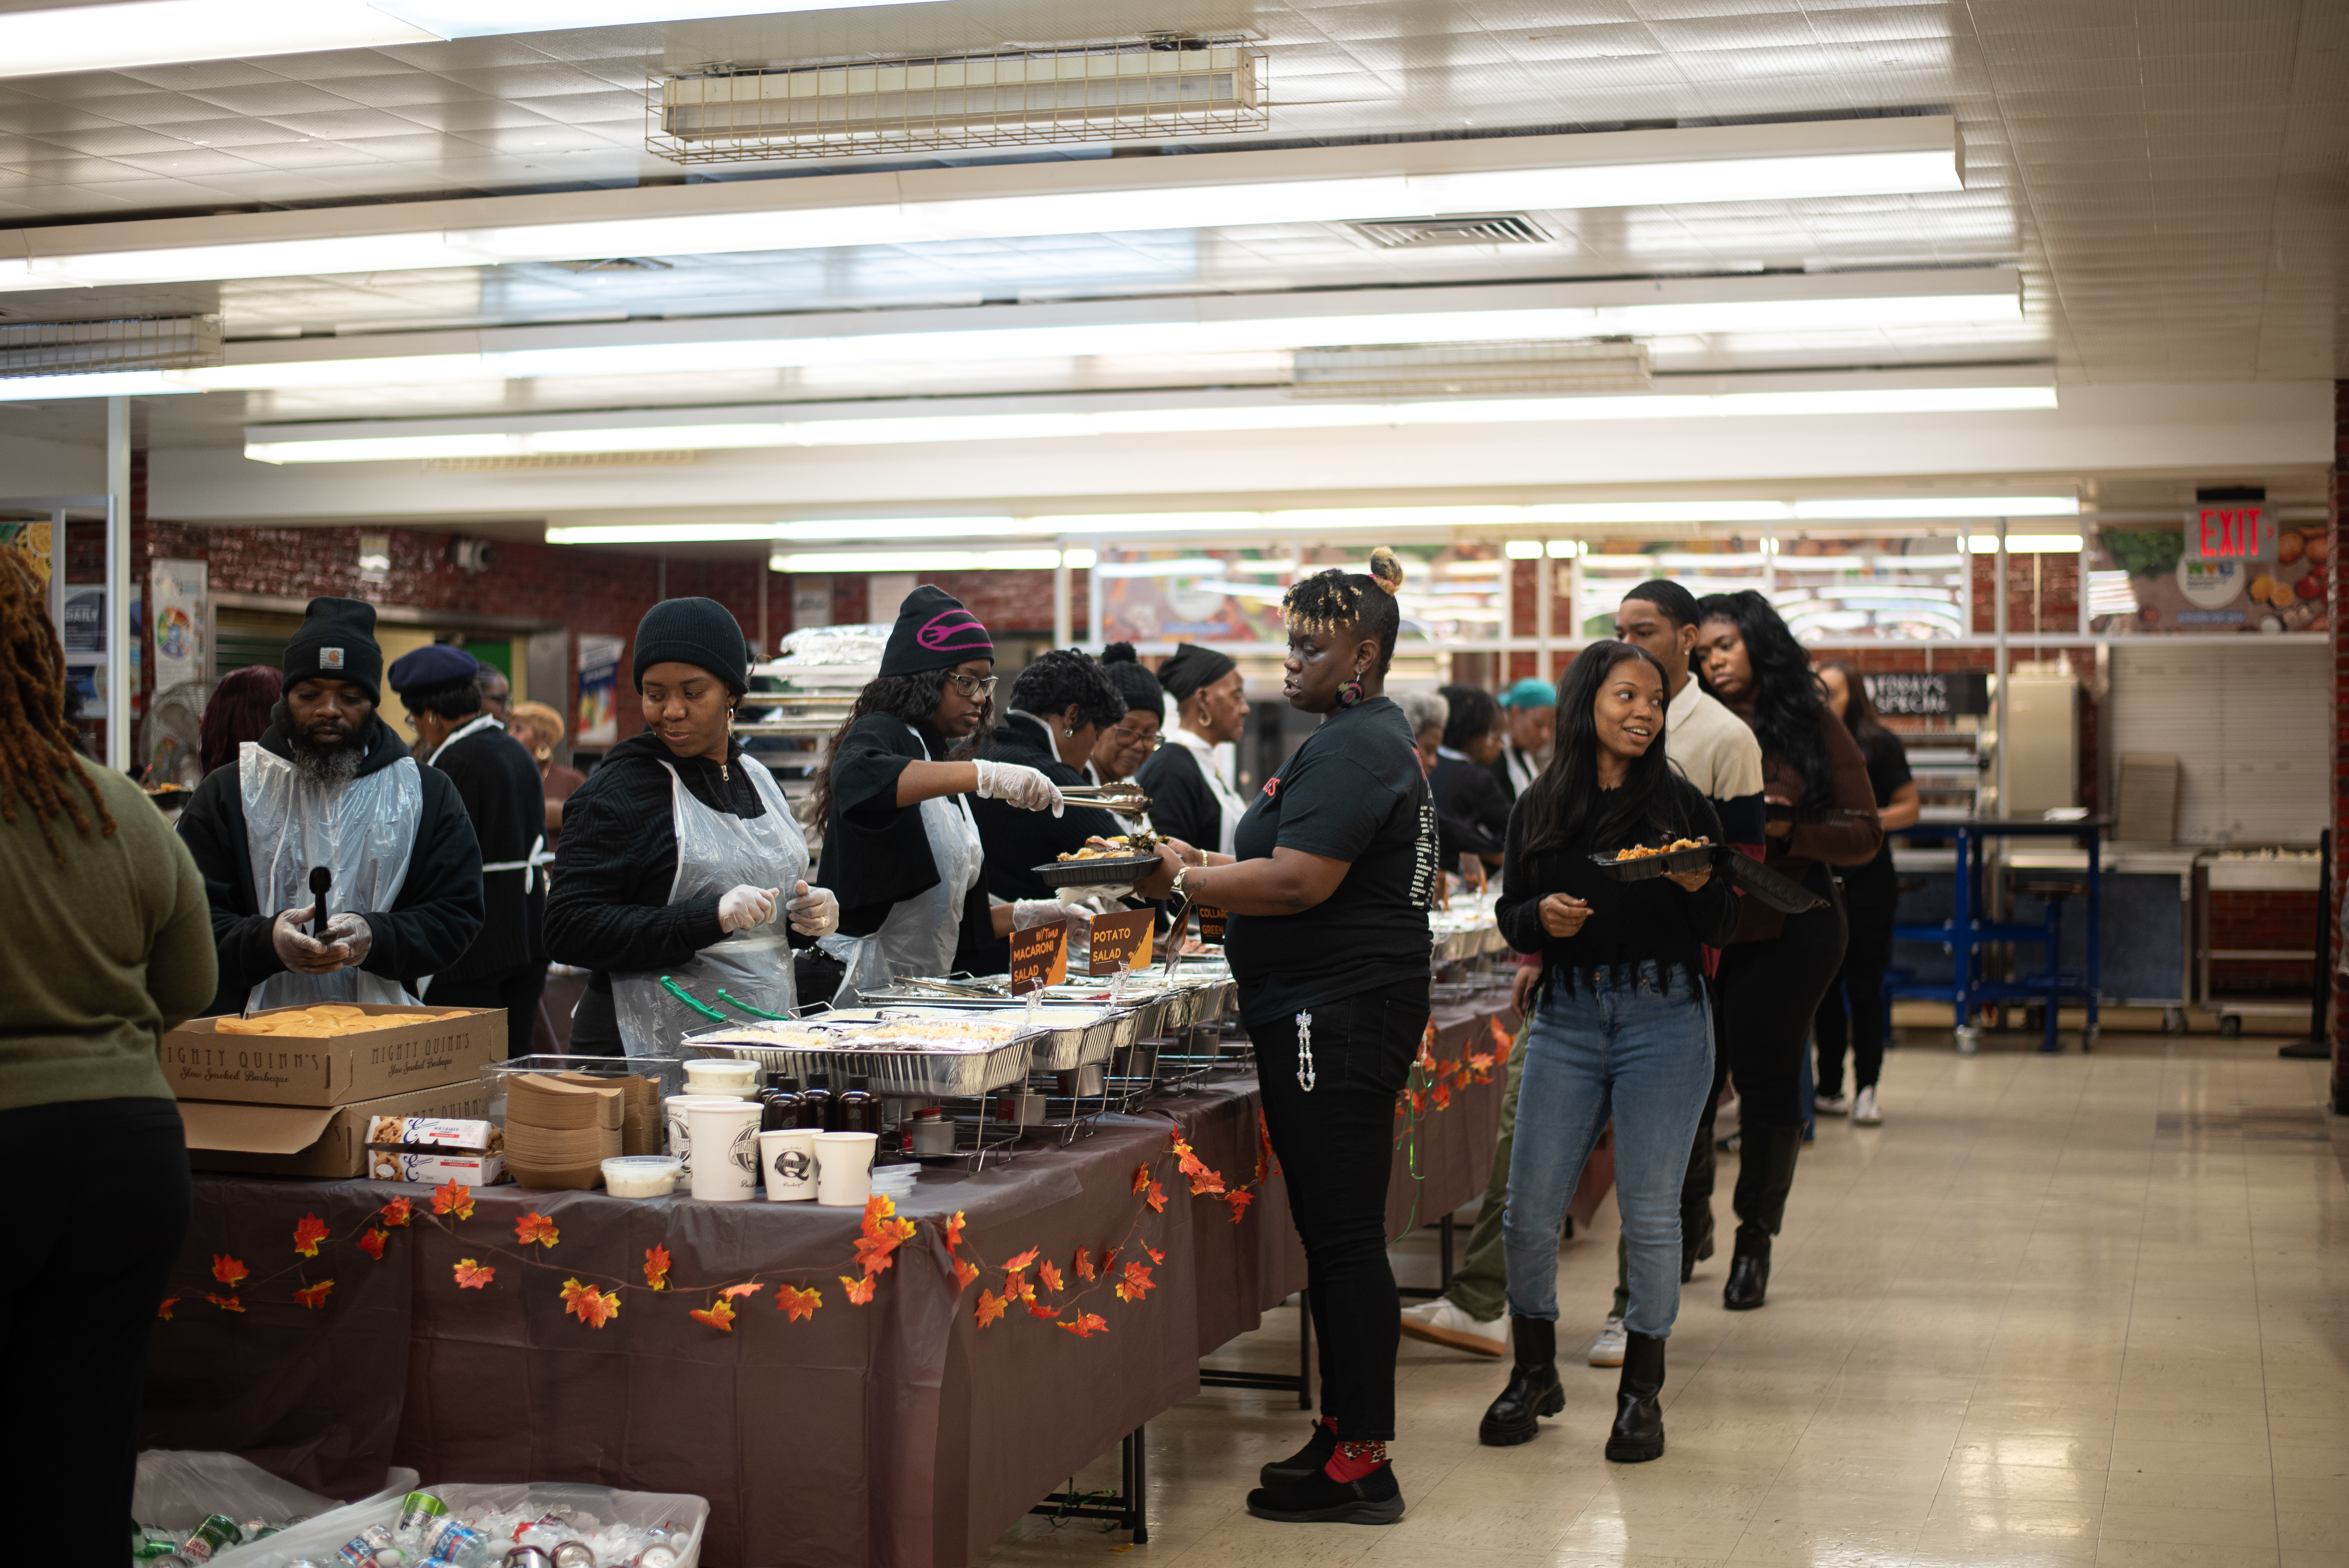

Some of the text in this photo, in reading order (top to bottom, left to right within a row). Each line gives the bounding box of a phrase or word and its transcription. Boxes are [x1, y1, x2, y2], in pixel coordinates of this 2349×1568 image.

[2199, 508, 2262, 557] EXIT
[1094, 928, 1130, 943] POTATO
[1202, 925, 1224, 935] GREEN
[1013, 940, 1054, 962] MACARONI
[1093, 948, 1121, 962] SALAD
[1014, 964, 1039, 982] SALAD
[372, 1033, 469, 1064] MIGHTY QUINN'S
[168, 1047, 319, 1070] IGHTY QUINN'S
[389, 1056, 453, 1077] Slow Smoked Barbeque
[180, 1066, 290, 1087] Slow Smoked Barbeque
[442, 1098, 481, 1119] QUINN'
[734, 1140, 756, 1154] MIGHTY
[741, 1180, 756, 1188] Barbe
[206, 1523, 226, 1539] GINGER
[182, 1545, 210, 1563] CANA
